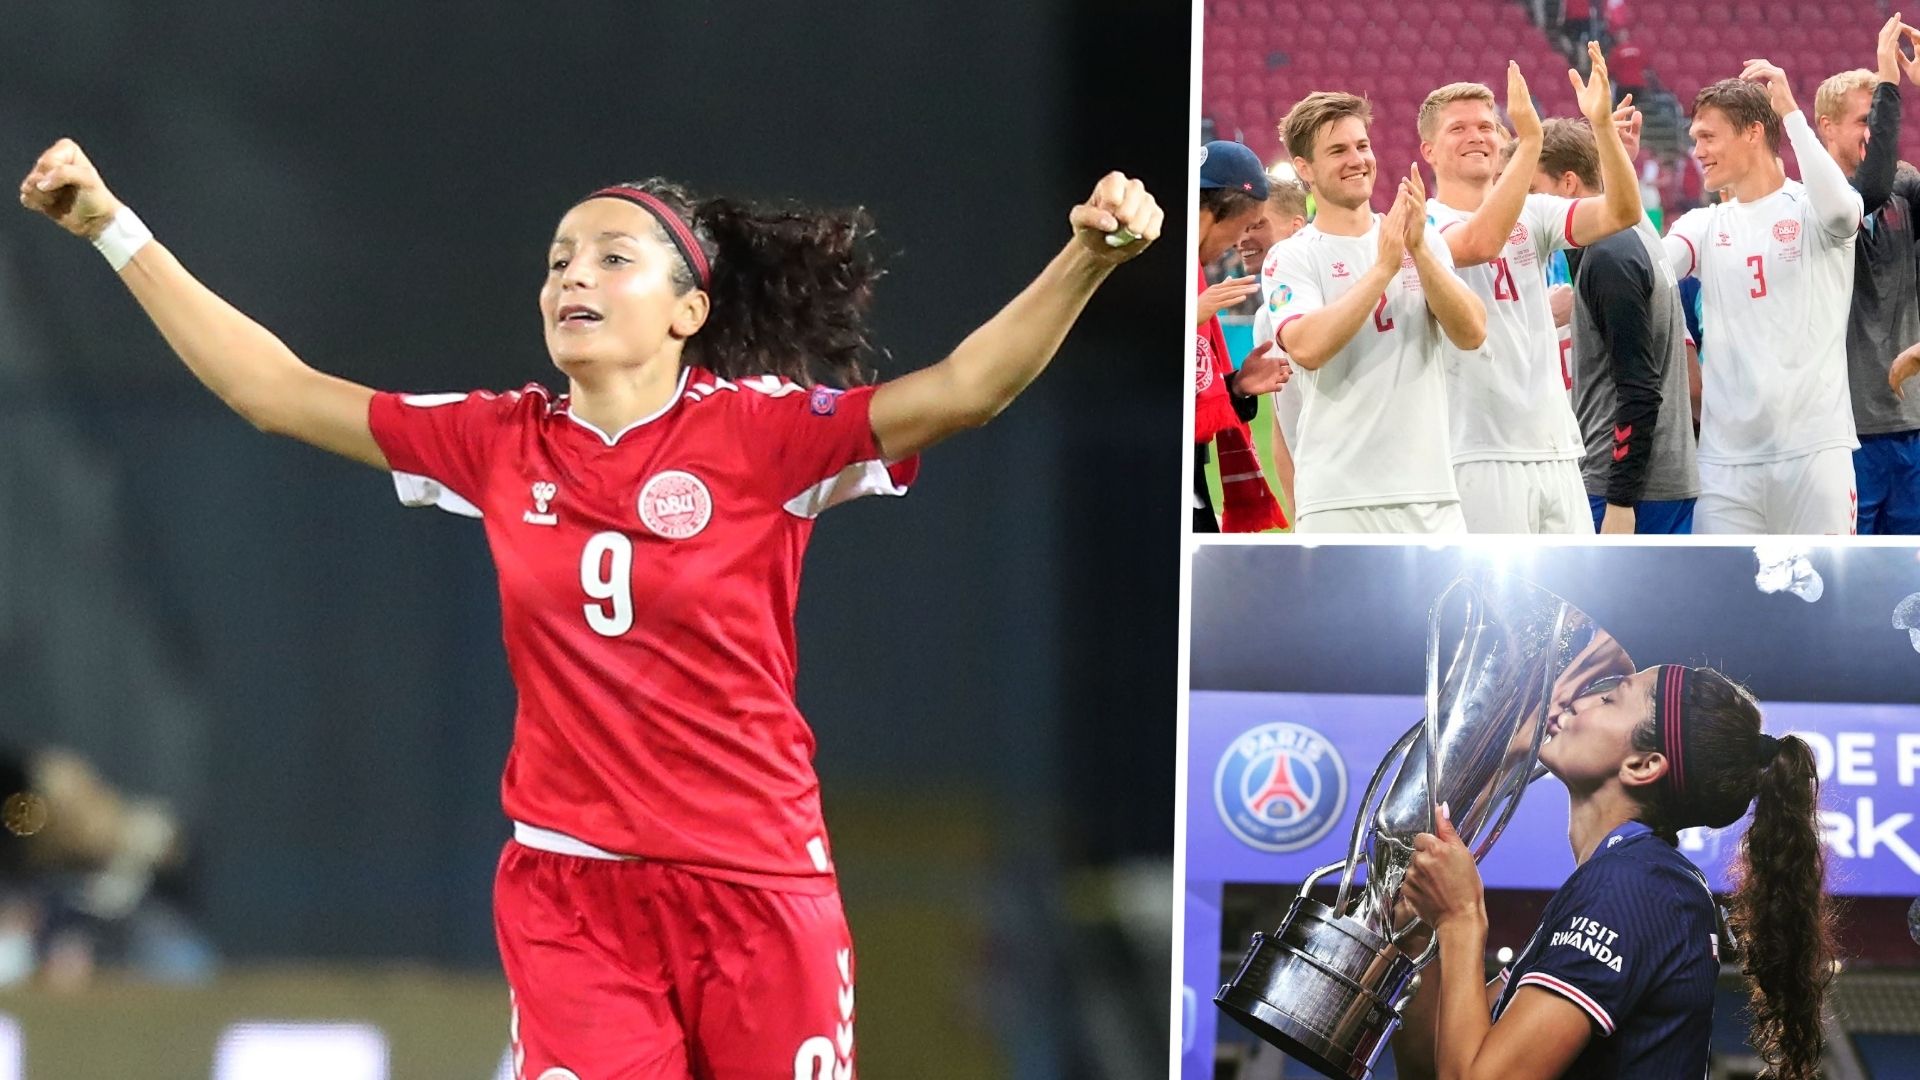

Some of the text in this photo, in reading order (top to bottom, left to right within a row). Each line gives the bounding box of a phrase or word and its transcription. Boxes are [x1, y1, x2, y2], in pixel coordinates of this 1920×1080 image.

[1489, 257, 1519, 302] 21
[1747, 255, 1767, 298] 3
[1374, 291, 1395, 333] 2
[656, 494, 694, 516] DBU
[581, 532, 633, 636] 9
[1240, 730, 1325, 762] PARIS
[1550, 931, 1623, 973] RWANDA
[1570, 916, 1619, 946] VISIT
